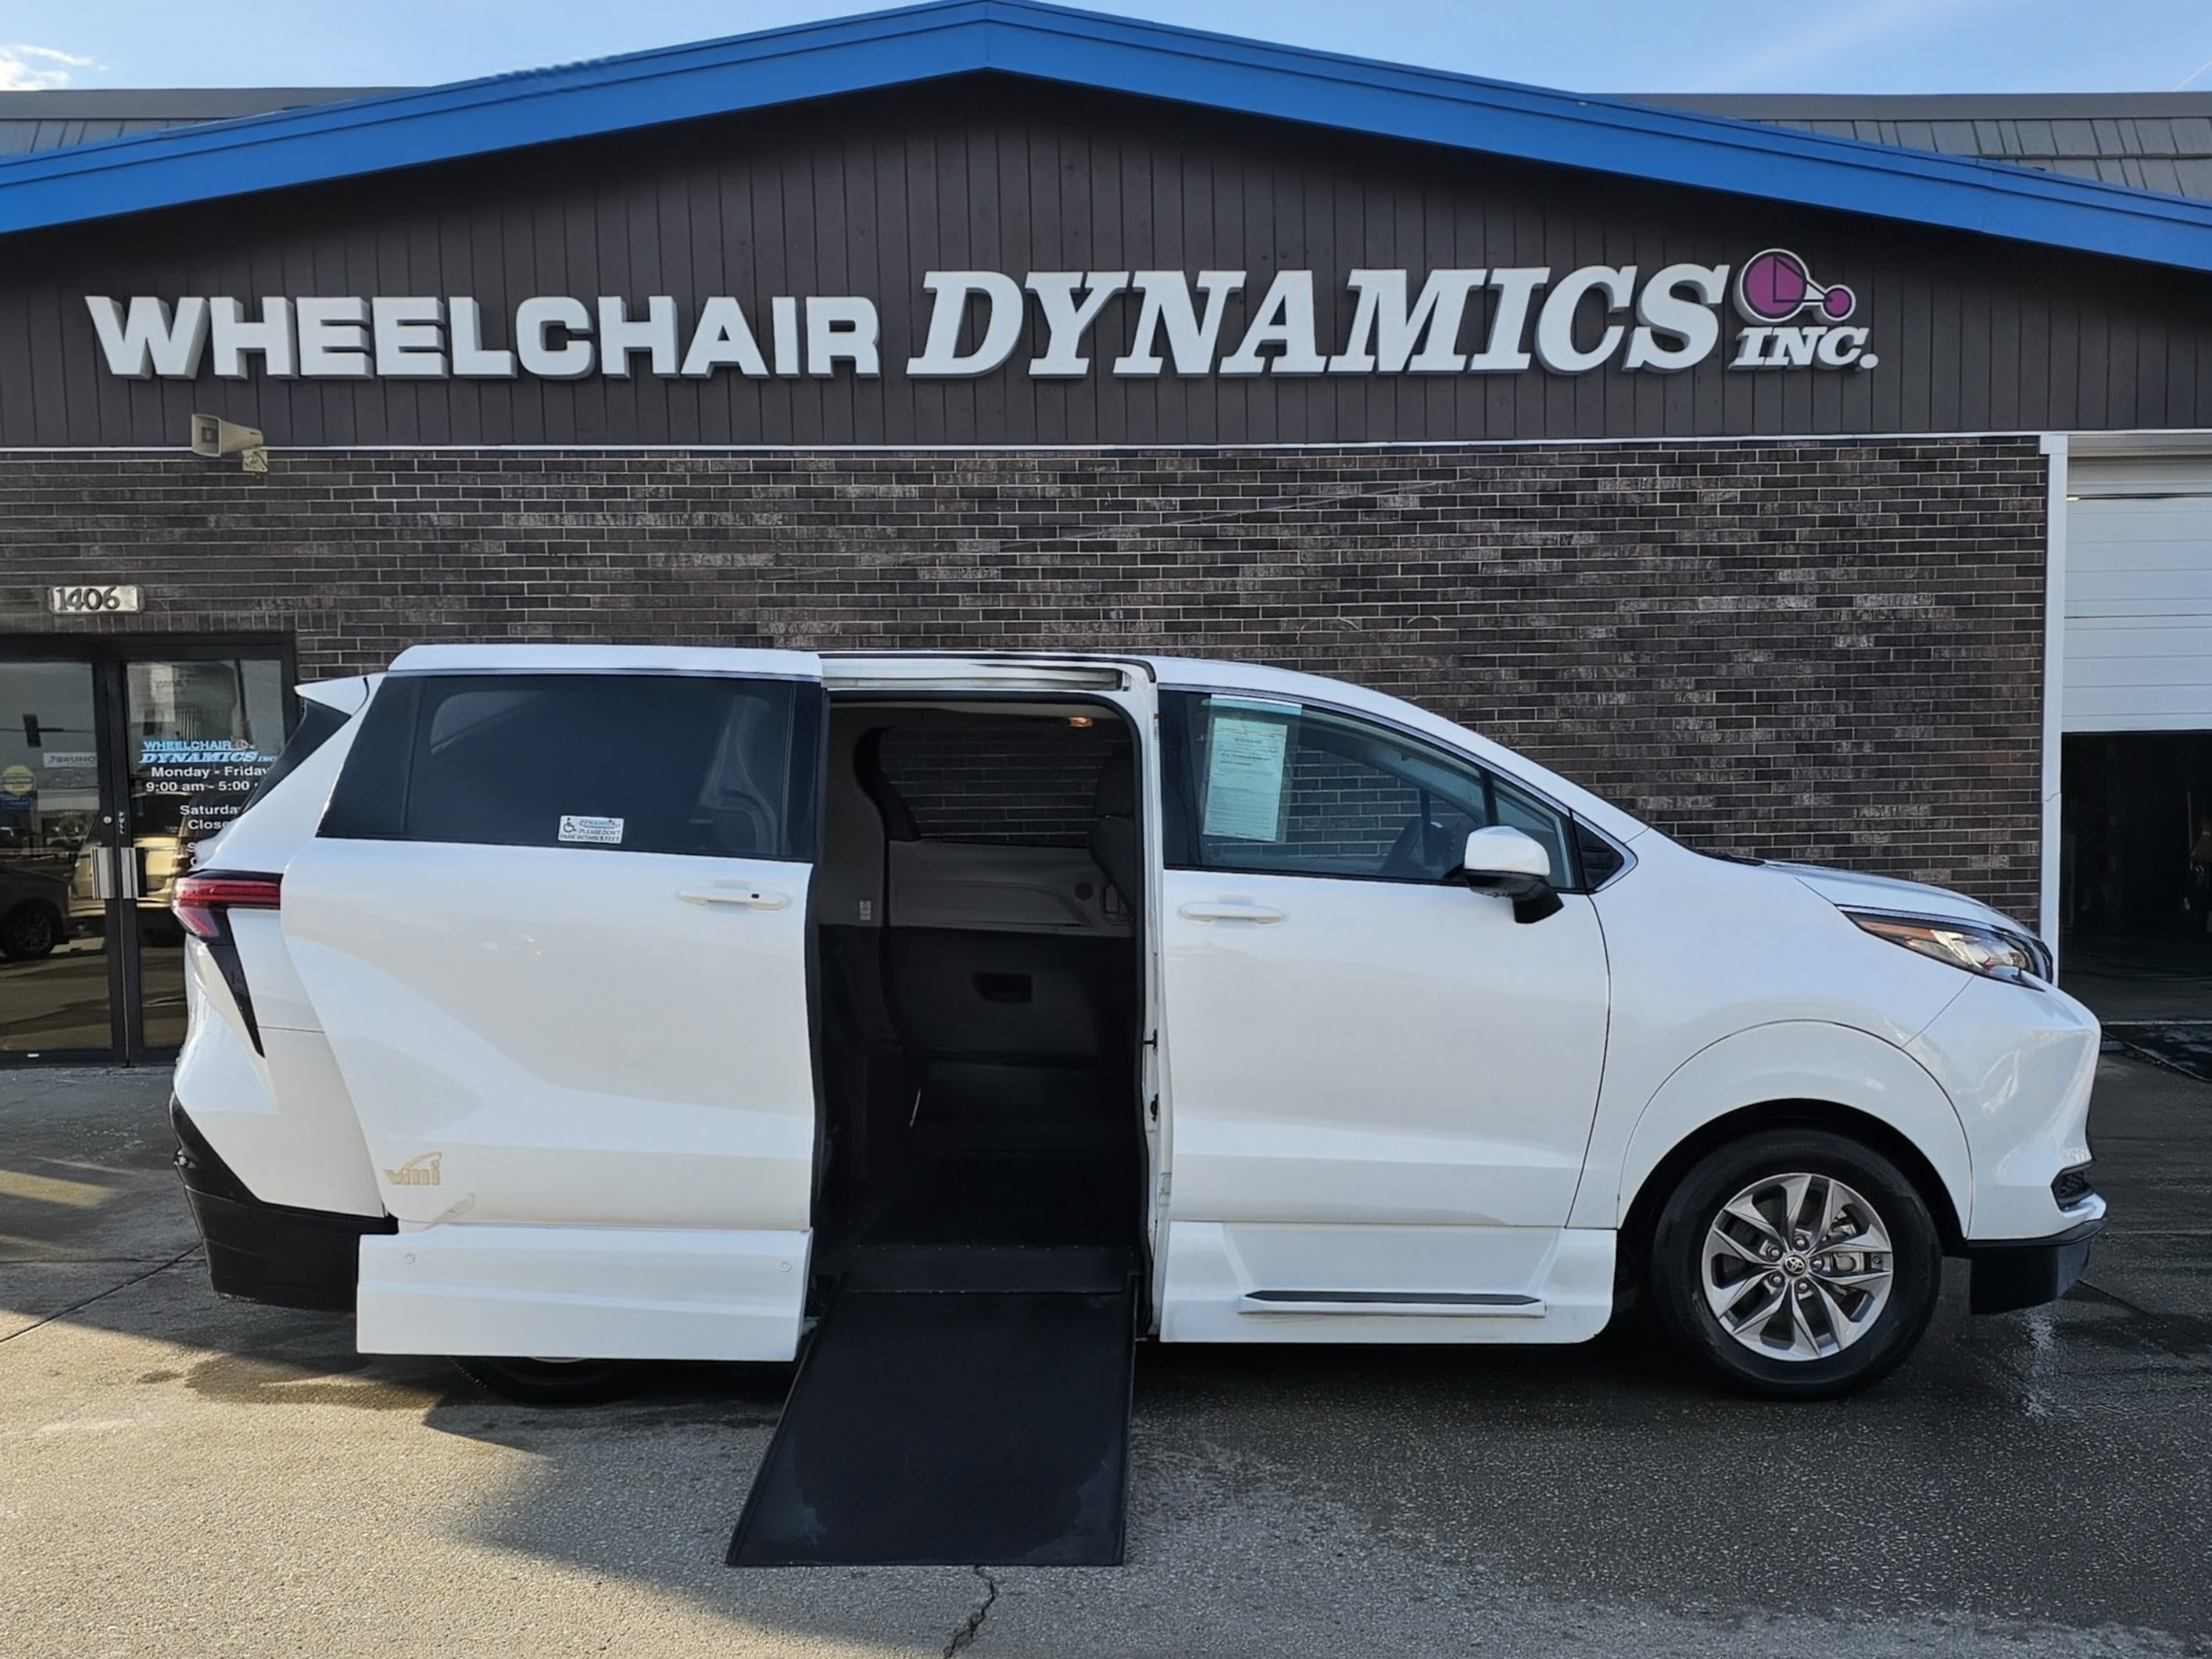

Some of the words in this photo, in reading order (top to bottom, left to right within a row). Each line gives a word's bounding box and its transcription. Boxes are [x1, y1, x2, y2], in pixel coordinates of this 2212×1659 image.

[84, 295, 880, 380] WHEELCHAIR
[904, 263, 1731, 378] DYNAMICS
[1727, 325, 1879, 372] INC.
[55, 585, 121, 611] 1406
[143, 740, 232, 750] WHEELCHAIR
[139, 751, 258, 763] DYNAMICS
[151, 767, 210, 779] Monday
[145, 781, 177, 792] 9:00
[181, 783, 205, 792] am
[218, 781, 250, 791] 5:00
[179, 805, 242, 815] Saturda
